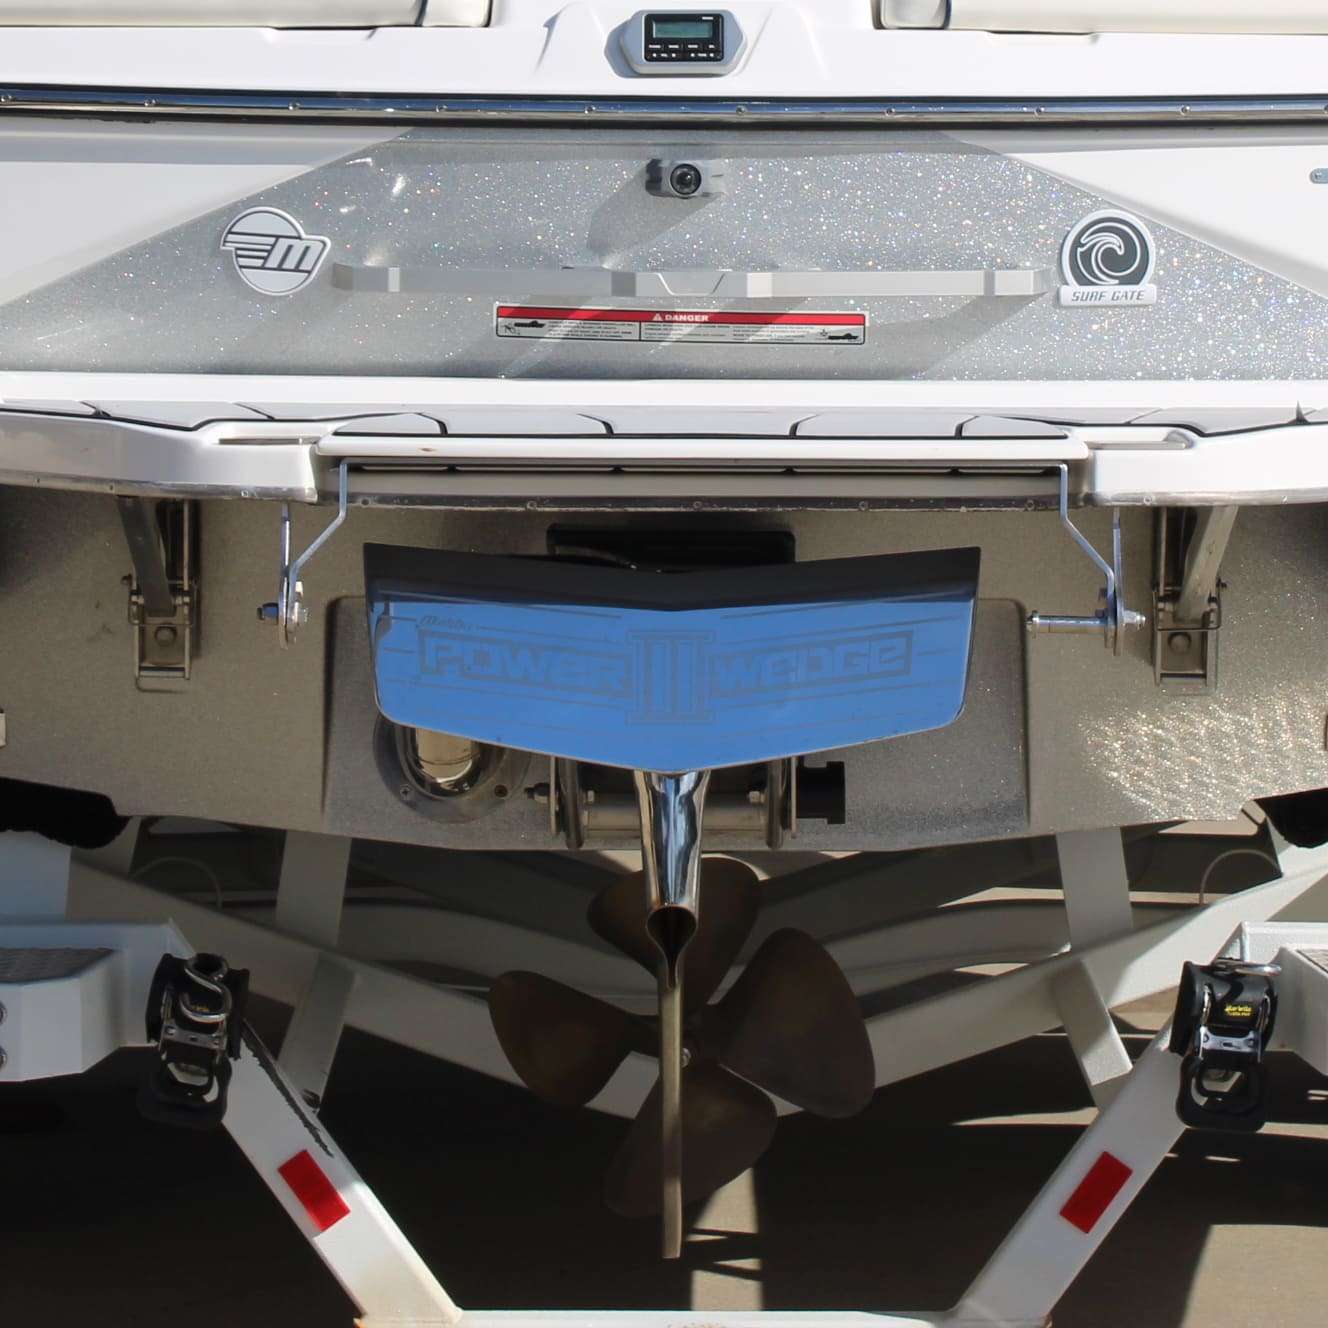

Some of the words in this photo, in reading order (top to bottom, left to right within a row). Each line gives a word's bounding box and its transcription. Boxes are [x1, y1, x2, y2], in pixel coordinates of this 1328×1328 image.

[1071, 290, 1107, 302] SURF
[1112, 289, 1146, 301] GATE
[664, 313, 709, 322] DANGER
